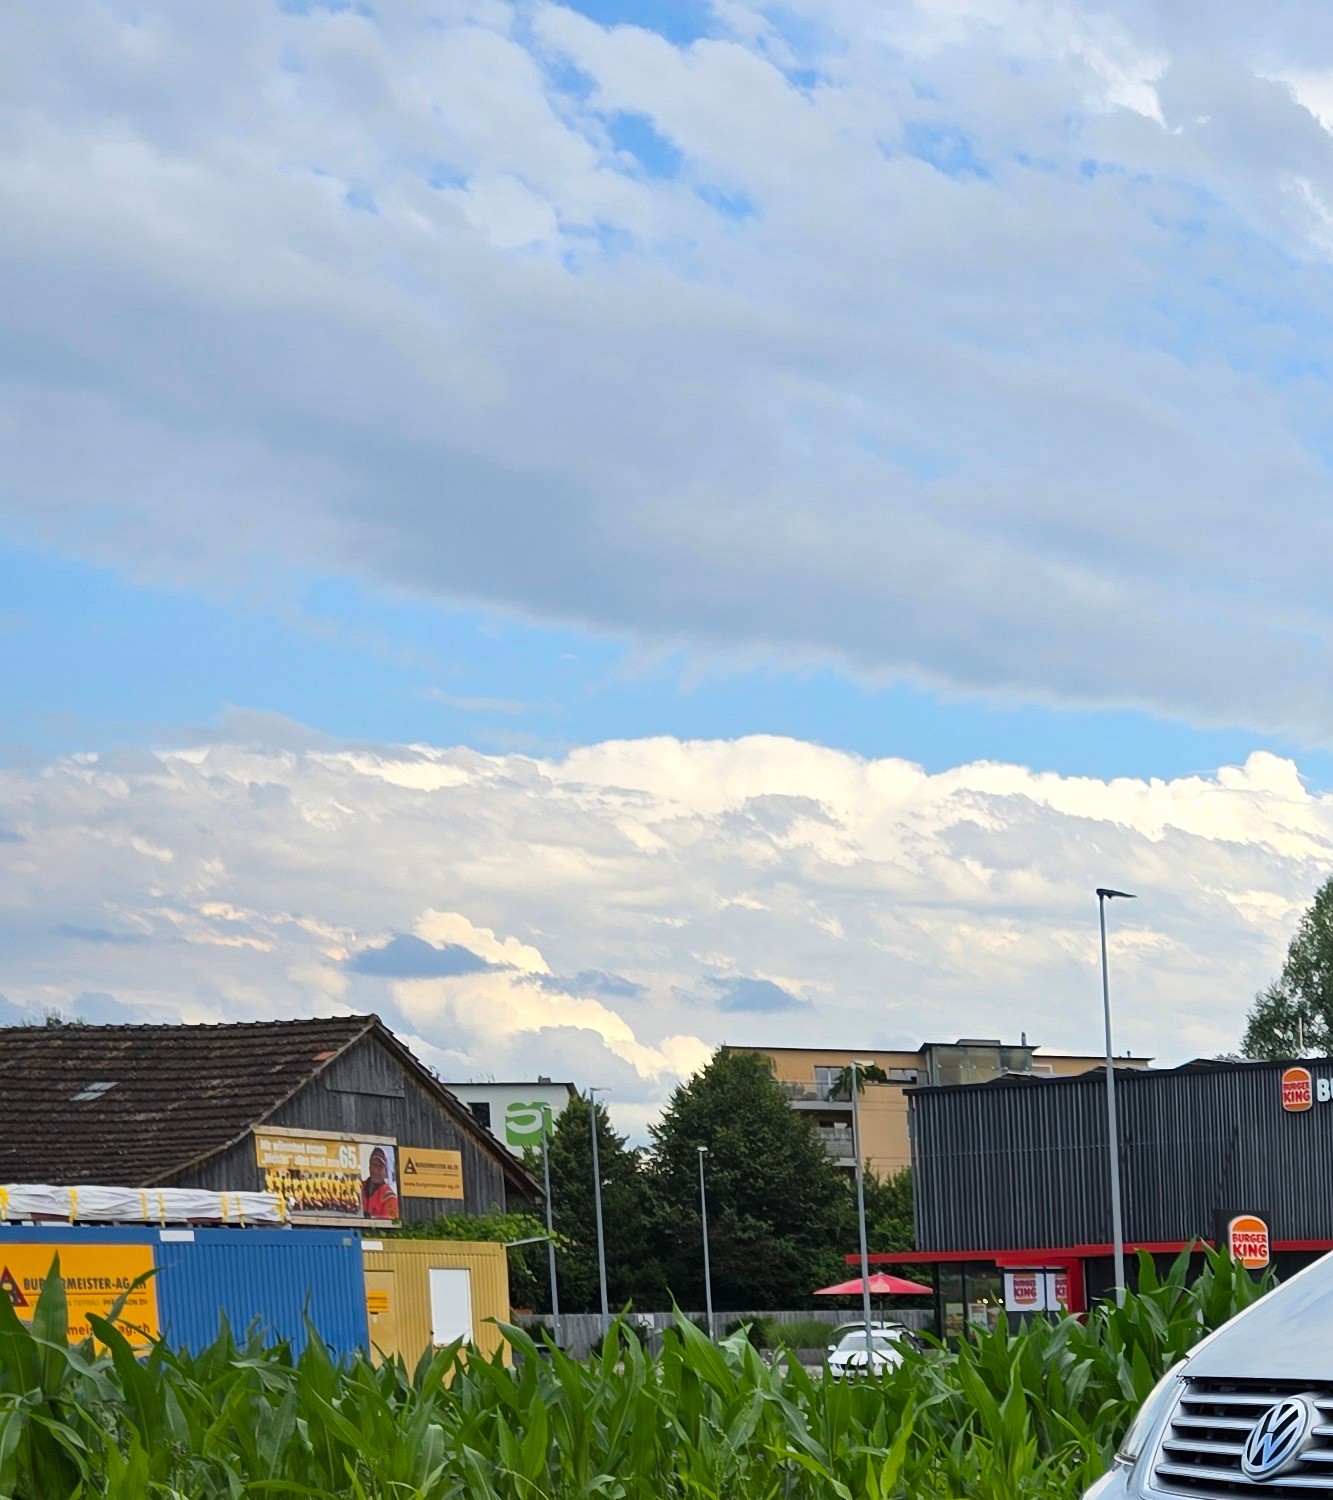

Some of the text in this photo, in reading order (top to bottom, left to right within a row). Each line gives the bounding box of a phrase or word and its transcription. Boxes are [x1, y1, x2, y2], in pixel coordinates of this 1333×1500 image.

[1284, 1082, 1310, 1091] BURGER
[1284, 1090, 1310, 1102] KING
[1232, 1233, 1267, 1243] BURGER
[1233, 1244, 1268, 1258] KING
[1013, 1286, 1037, 1298] KING
